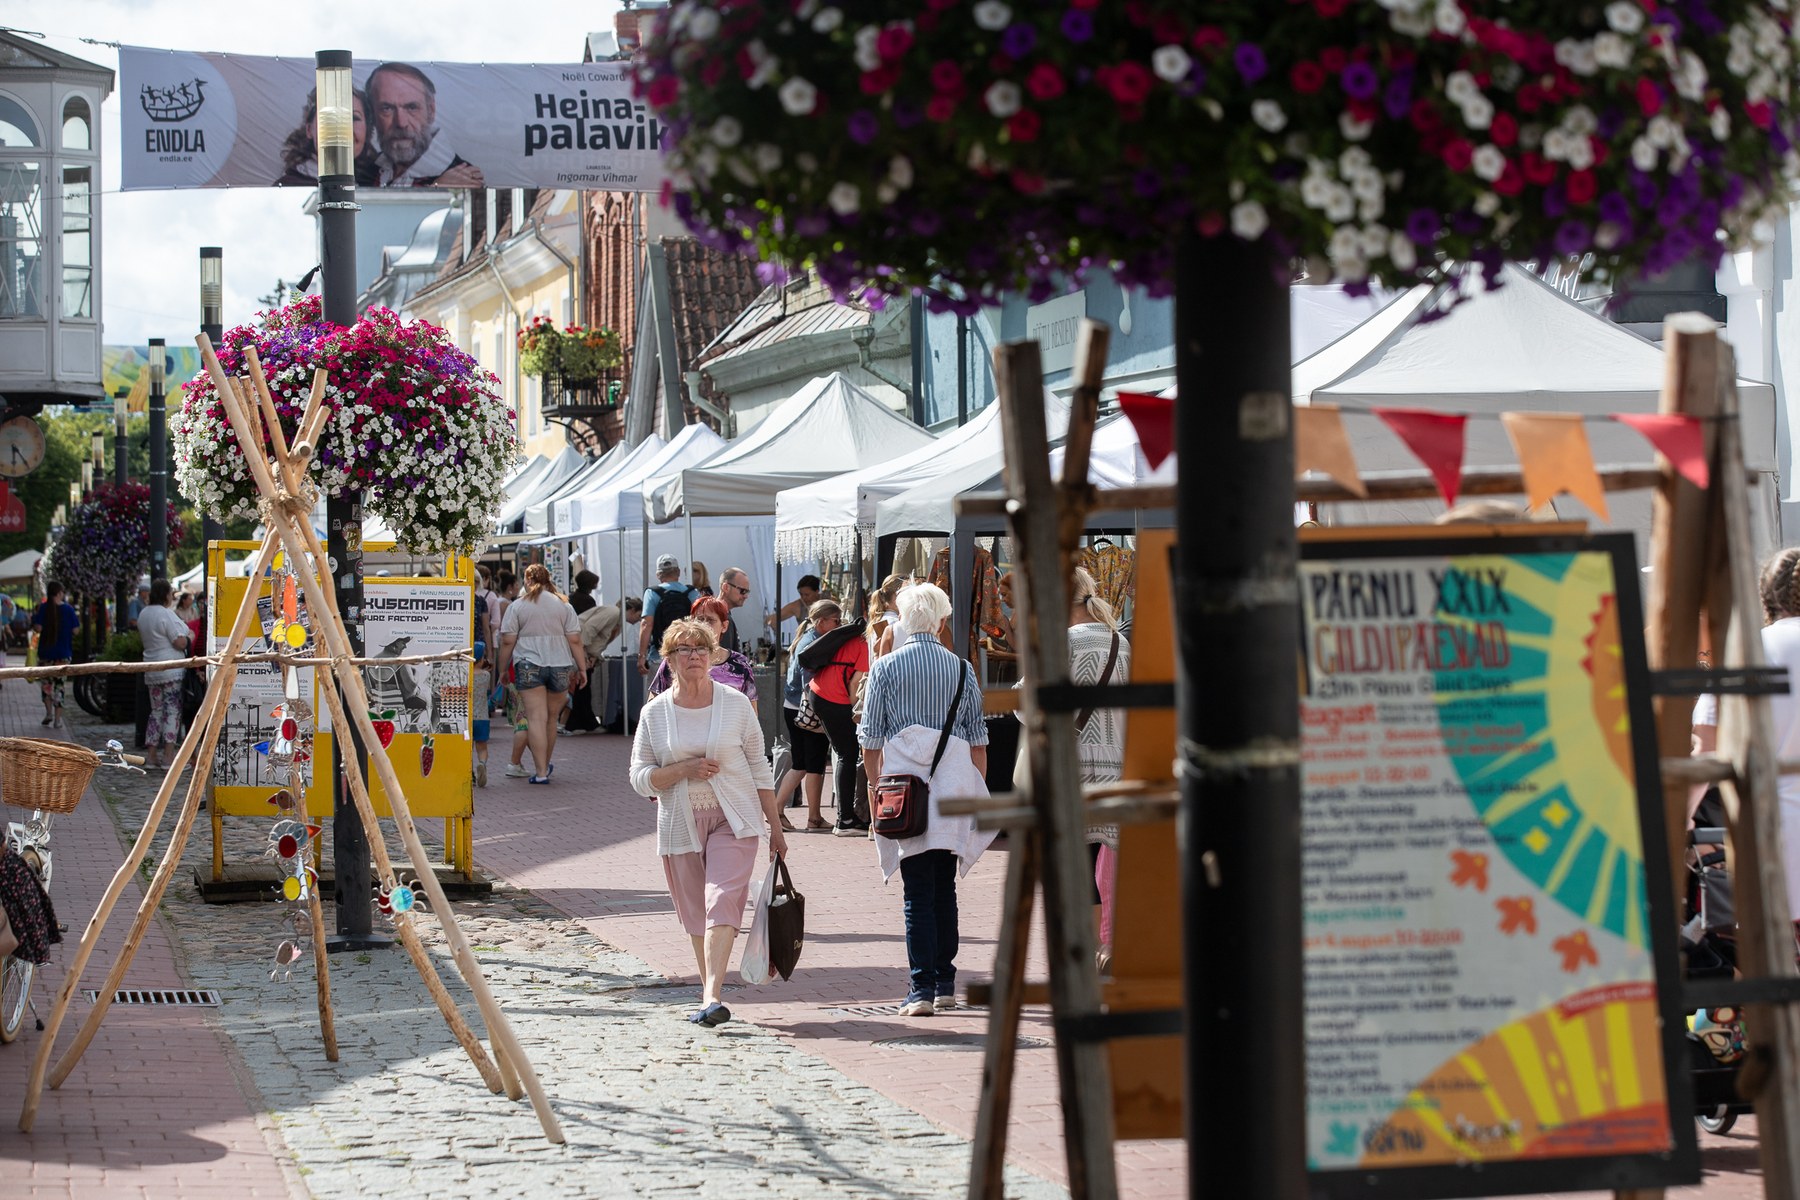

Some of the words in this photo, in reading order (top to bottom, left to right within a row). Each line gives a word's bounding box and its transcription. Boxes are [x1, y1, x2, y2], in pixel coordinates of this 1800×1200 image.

[562, 72, 585, 82] Noël
[588, 72, 626, 82] Coward
[534, 89, 646, 120] Heina-
[145, 129, 206, 153] ENDLA
[557, 172, 600, 184] Ingomar
[602, 172, 638, 183] Vihmar
[1428, 566, 1511, 616] XXIX
